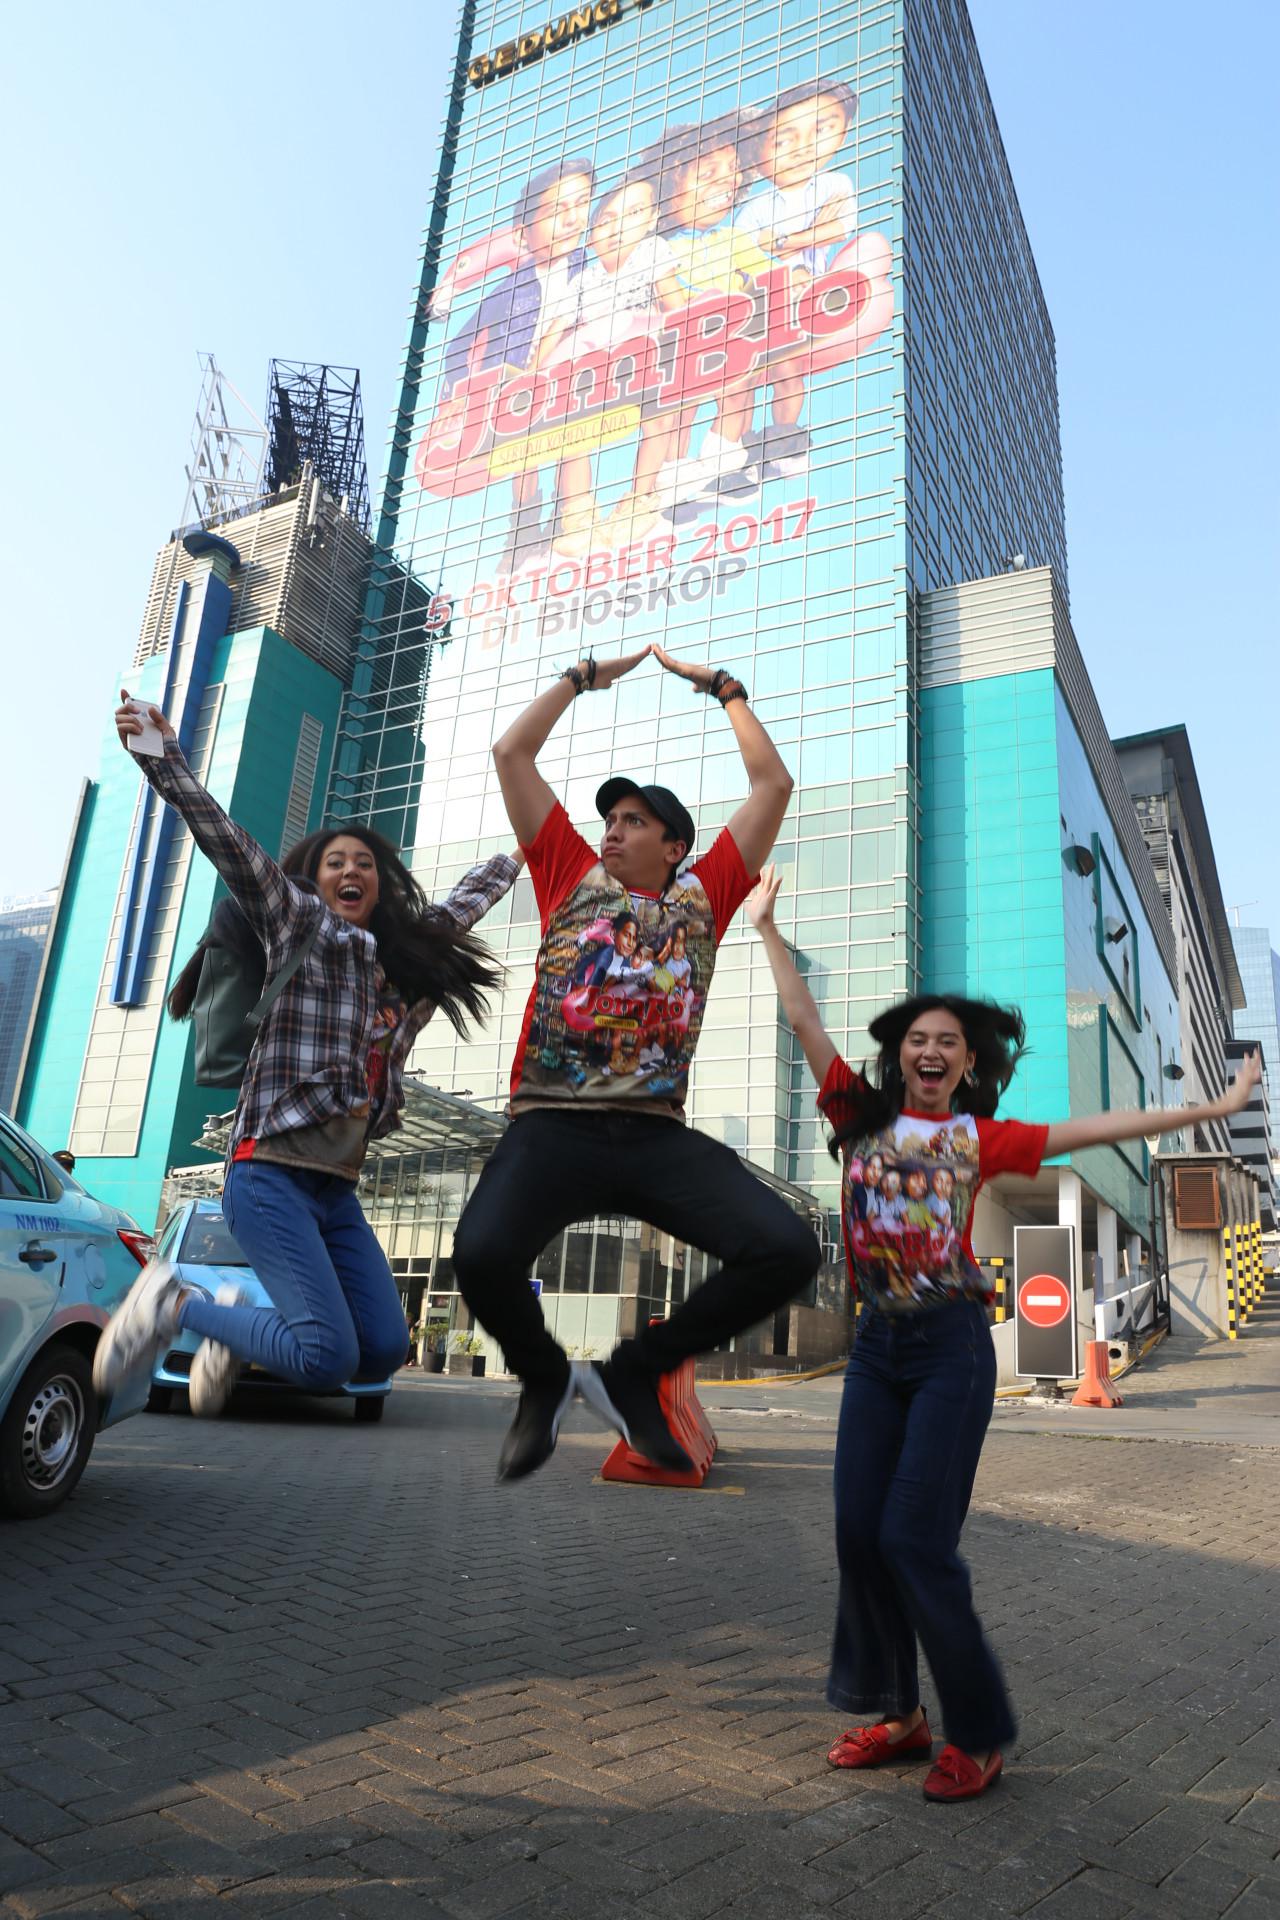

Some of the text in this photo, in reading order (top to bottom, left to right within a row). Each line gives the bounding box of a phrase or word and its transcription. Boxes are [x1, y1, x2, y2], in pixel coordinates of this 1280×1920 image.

[467, 0, 620, 84] GEDUNG
[423, 499, 817, 632] 5 OKTOBER 2017
[480, 556, 748, 651] DI BIOSKOP
[15, 1214, 38, 1232] NM
